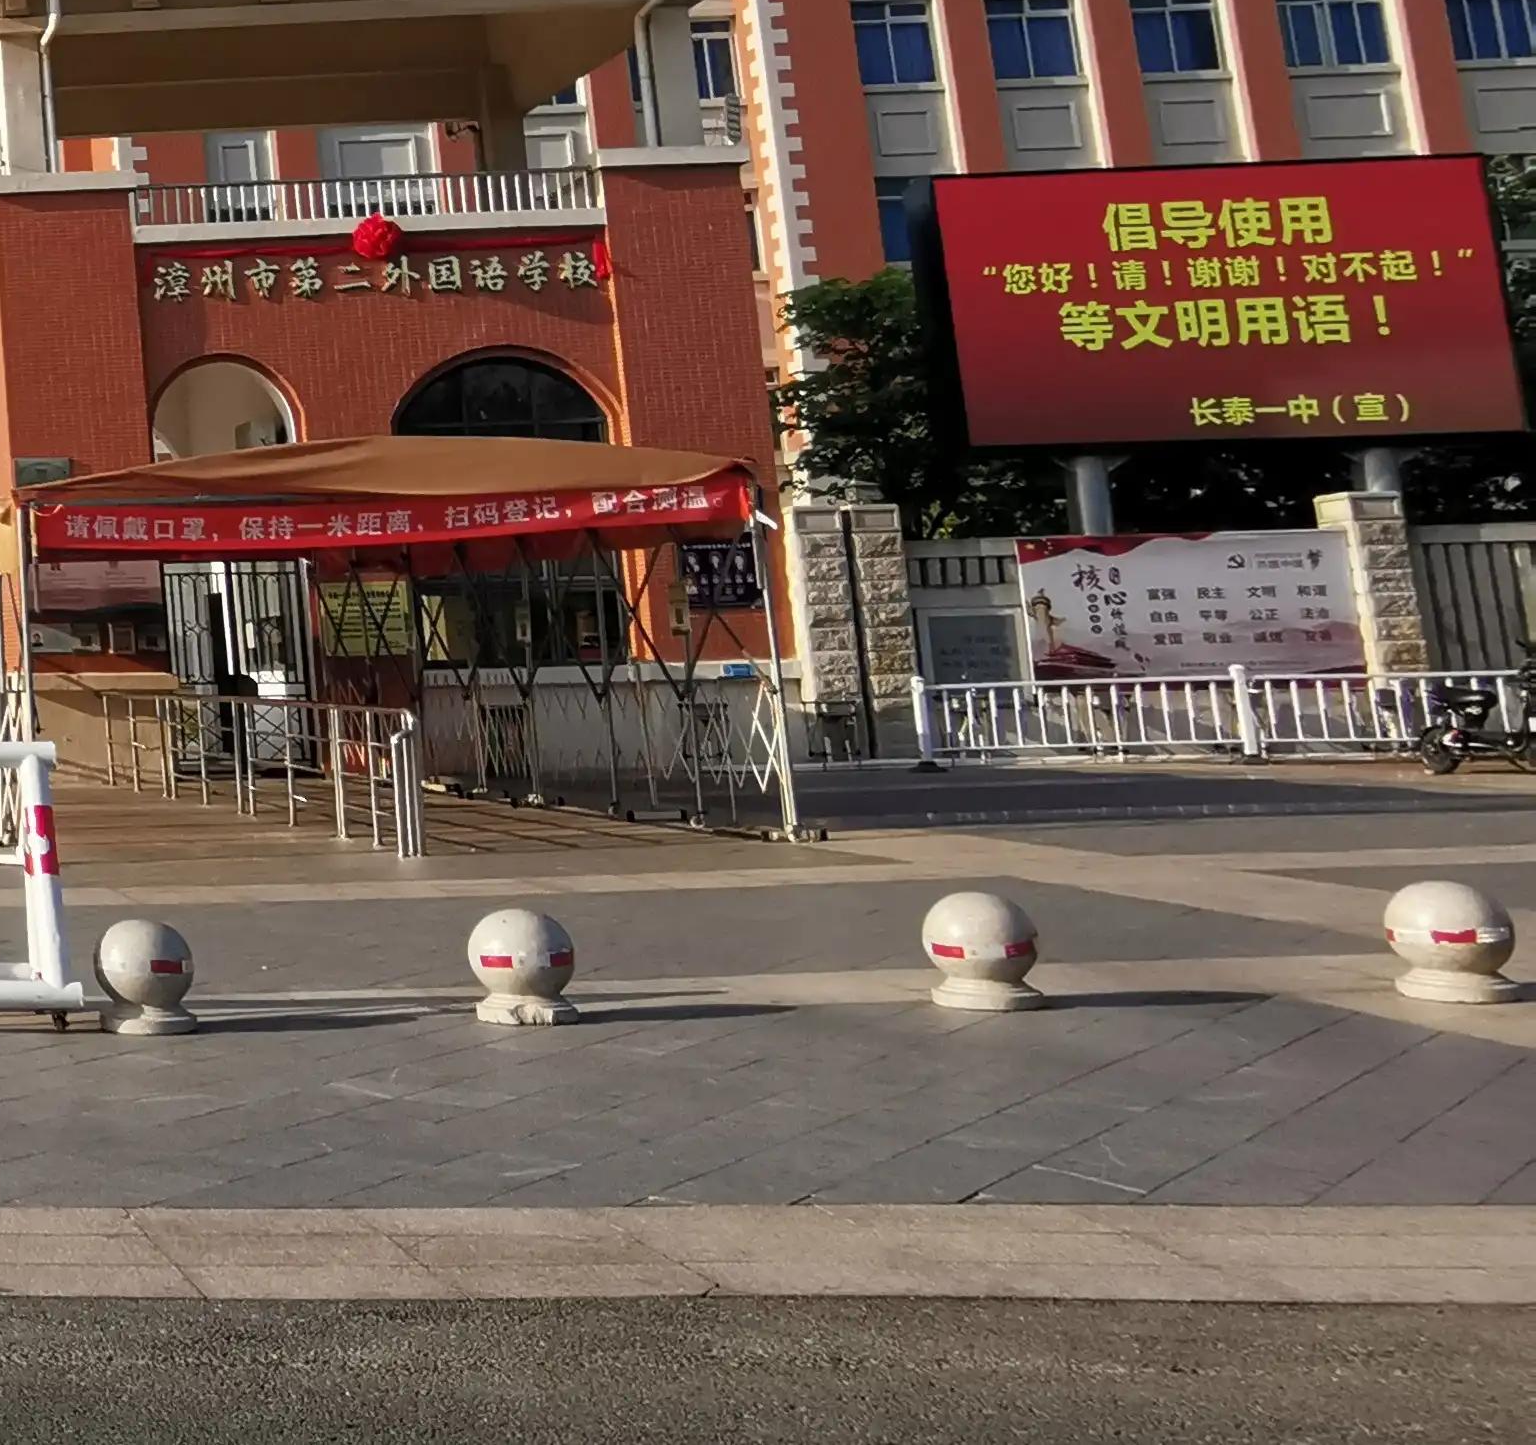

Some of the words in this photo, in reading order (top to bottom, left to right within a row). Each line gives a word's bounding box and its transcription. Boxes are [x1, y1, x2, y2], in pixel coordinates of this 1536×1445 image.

[1103, 197, 1333, 252] 倡导使用
[153, 251, 598, 303] 漳州市第二外国语学校
[1059, 295, 1394, 350] 等文明用语！
[1190, 394, 1410, 427] 长泰一中（宣）
[1197, 587, 1225, 599] 民主
[1247, 585, 1276, 598] 文明
[1150, 611, 1179, 623] 自由
[1199, 609, 1227, 621] 平等
[1249, 608, 1278, 621] 公正
